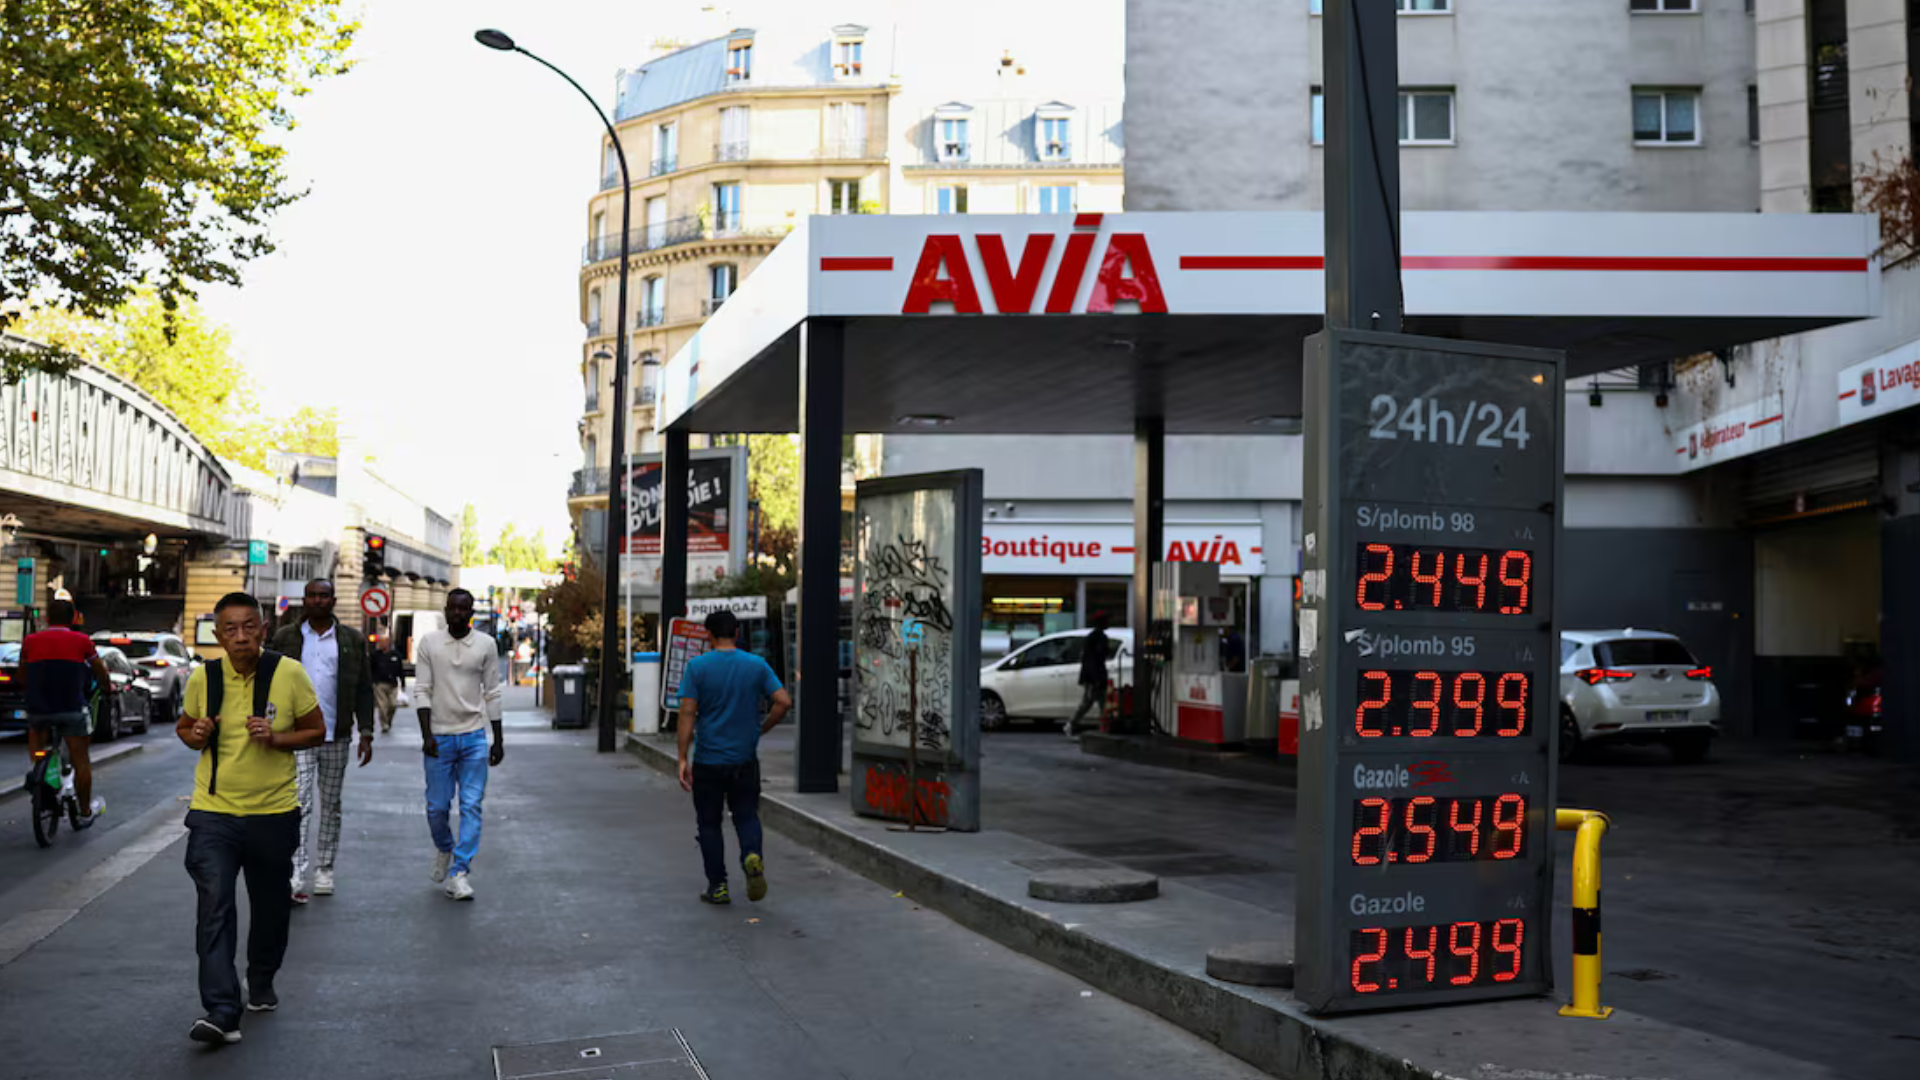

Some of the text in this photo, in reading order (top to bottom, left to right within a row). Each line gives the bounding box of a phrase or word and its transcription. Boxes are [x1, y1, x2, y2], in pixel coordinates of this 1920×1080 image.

[1369, 395, 1530, 450] 24h/24
[1356, 506, 1475, 532] S/plomb 98
[981, 535, 1101, 564] Boutique
[1356, 544, 1531, 615] 2.449
[691, 602, 758, 615] PRIMAGAZ
[1356, 634, 1475, 659] S/plomb 95
[1355, 670, 1528, 738] 2.399
[1353, 763, 1409, 789] Gazole
[1352, 794, 1525, 865] 2.549
[1350, 892, 1425, 916] Gazole
[1352, 918, 1525, 993] 2.499
